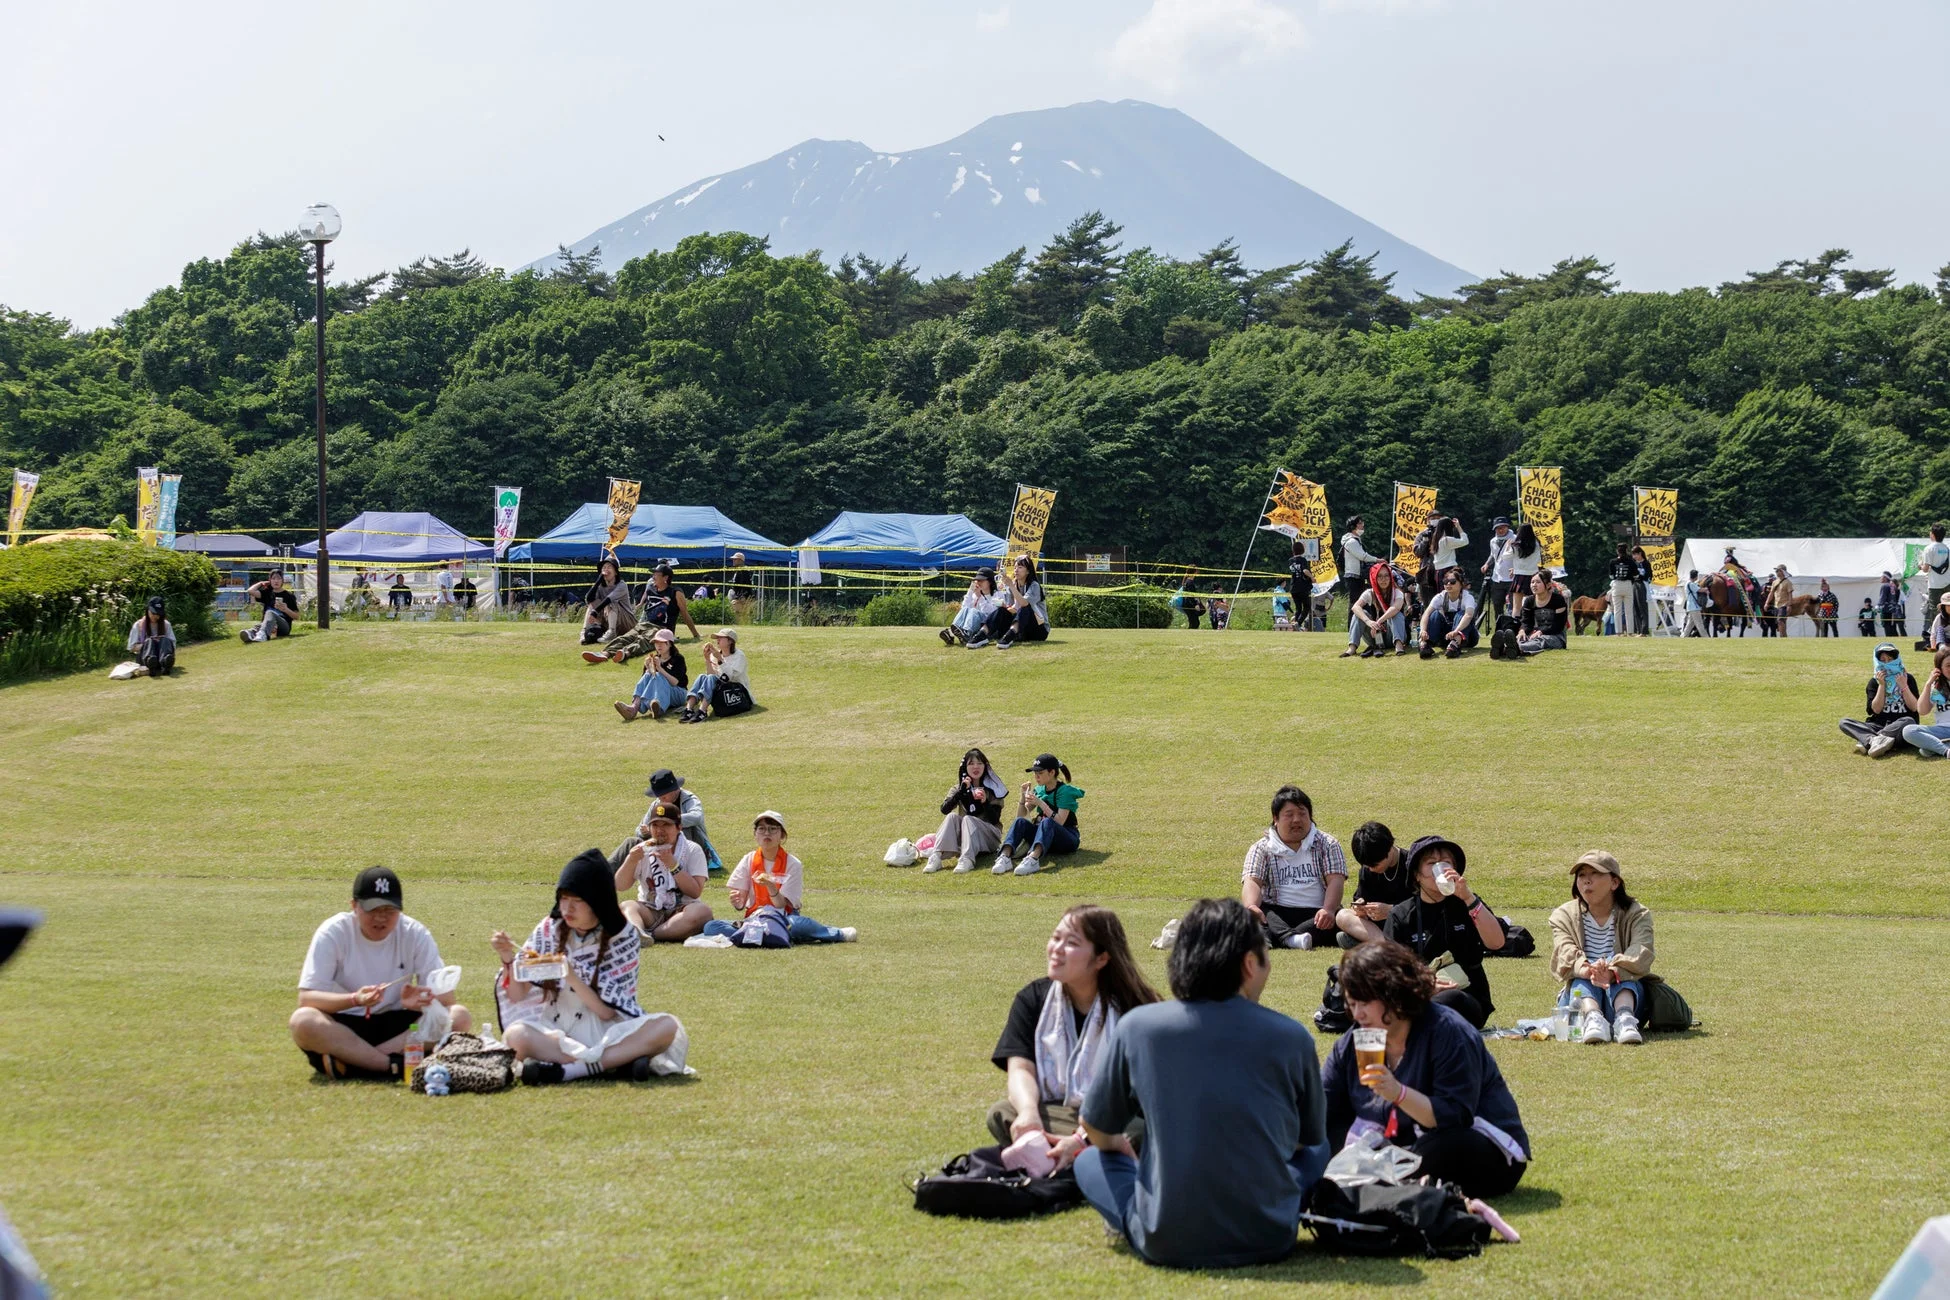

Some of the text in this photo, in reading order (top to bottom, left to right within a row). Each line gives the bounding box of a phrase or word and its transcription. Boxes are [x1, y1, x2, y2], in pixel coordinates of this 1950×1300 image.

[1526, 485, 1559, 500] CHAGU
[1524, 494, 1557, 510] ROCK
[1020, 502, 1049, 520] CHAGU
[1643, 505, 1675, 522] CHAGU
[1016, 512, 1045, 529] ROCK
[1641, 513, 1672, 532] ROCK
[726, 692, 741, 704] Lee
[375, 877, 390, 894] NY
